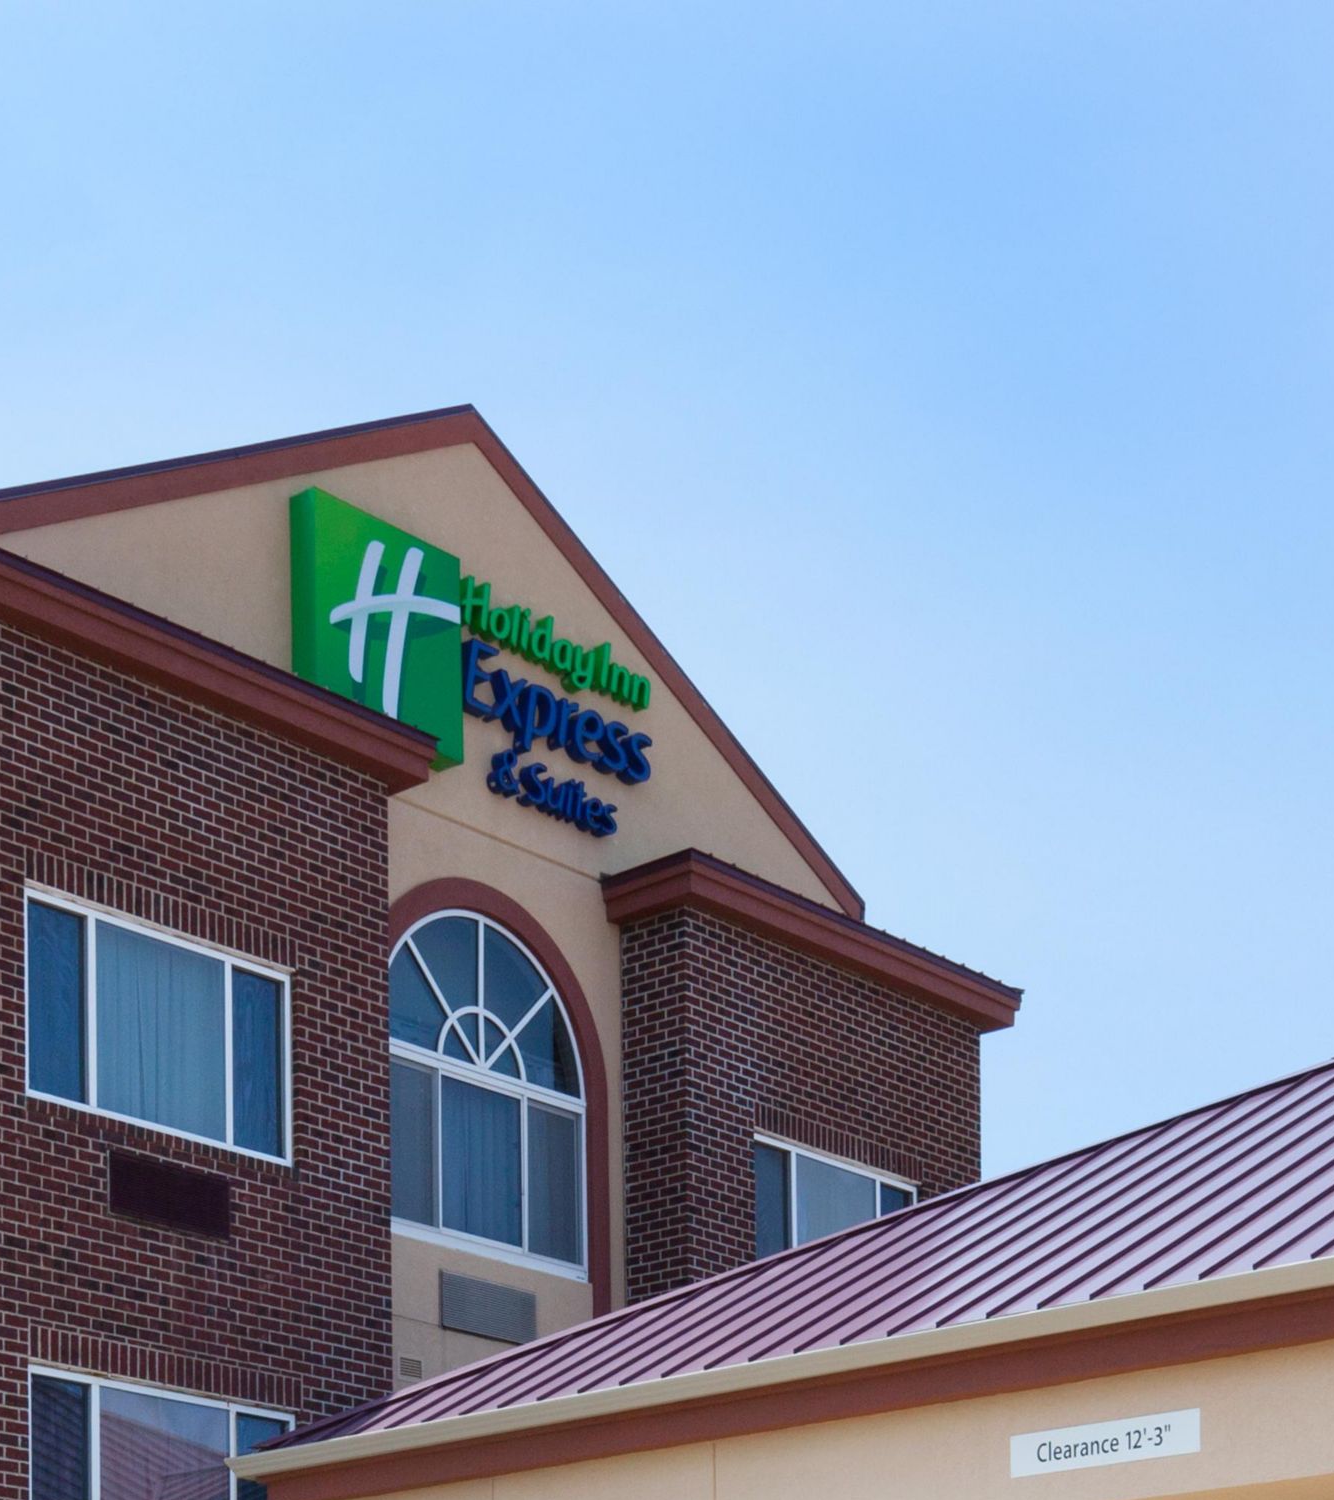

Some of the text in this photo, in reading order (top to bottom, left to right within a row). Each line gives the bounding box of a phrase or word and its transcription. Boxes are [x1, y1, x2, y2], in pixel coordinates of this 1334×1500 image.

[461, 575, 650, 712] Holiday Inn
[463, 638, 652, 785] Express
[487, 748, 618, 837] & Suites
[1036, 1423, 1171, 1463] Clearance 12'-3"
